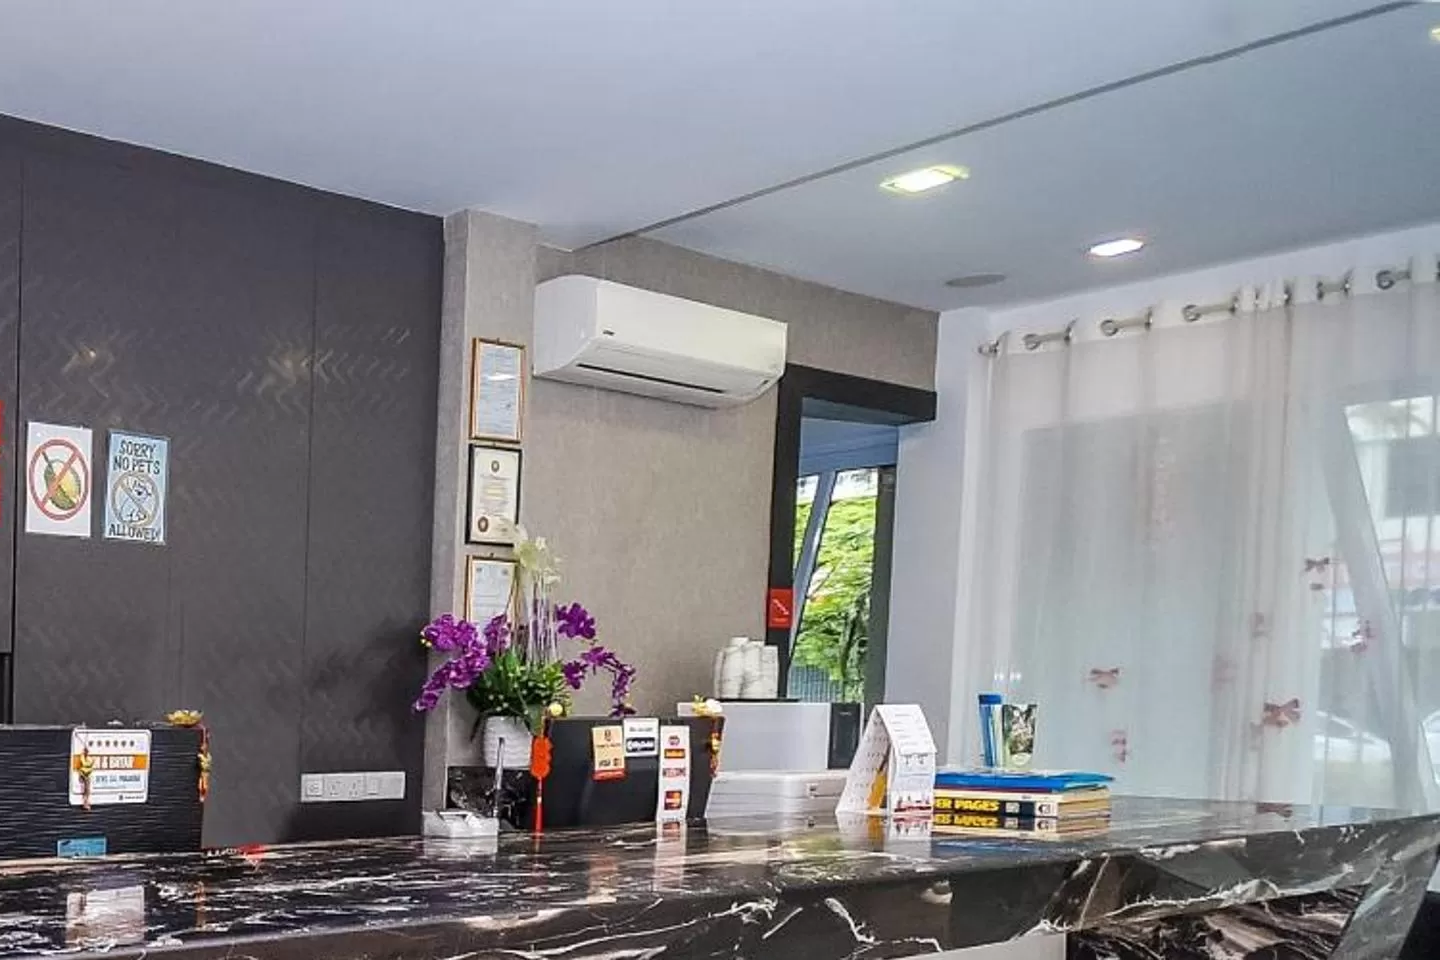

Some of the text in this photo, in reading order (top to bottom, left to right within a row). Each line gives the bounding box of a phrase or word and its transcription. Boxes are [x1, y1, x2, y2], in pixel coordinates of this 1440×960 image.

[119, 439, 157, 460] SORRY
[113, 455, 160, 475] NO PETS
